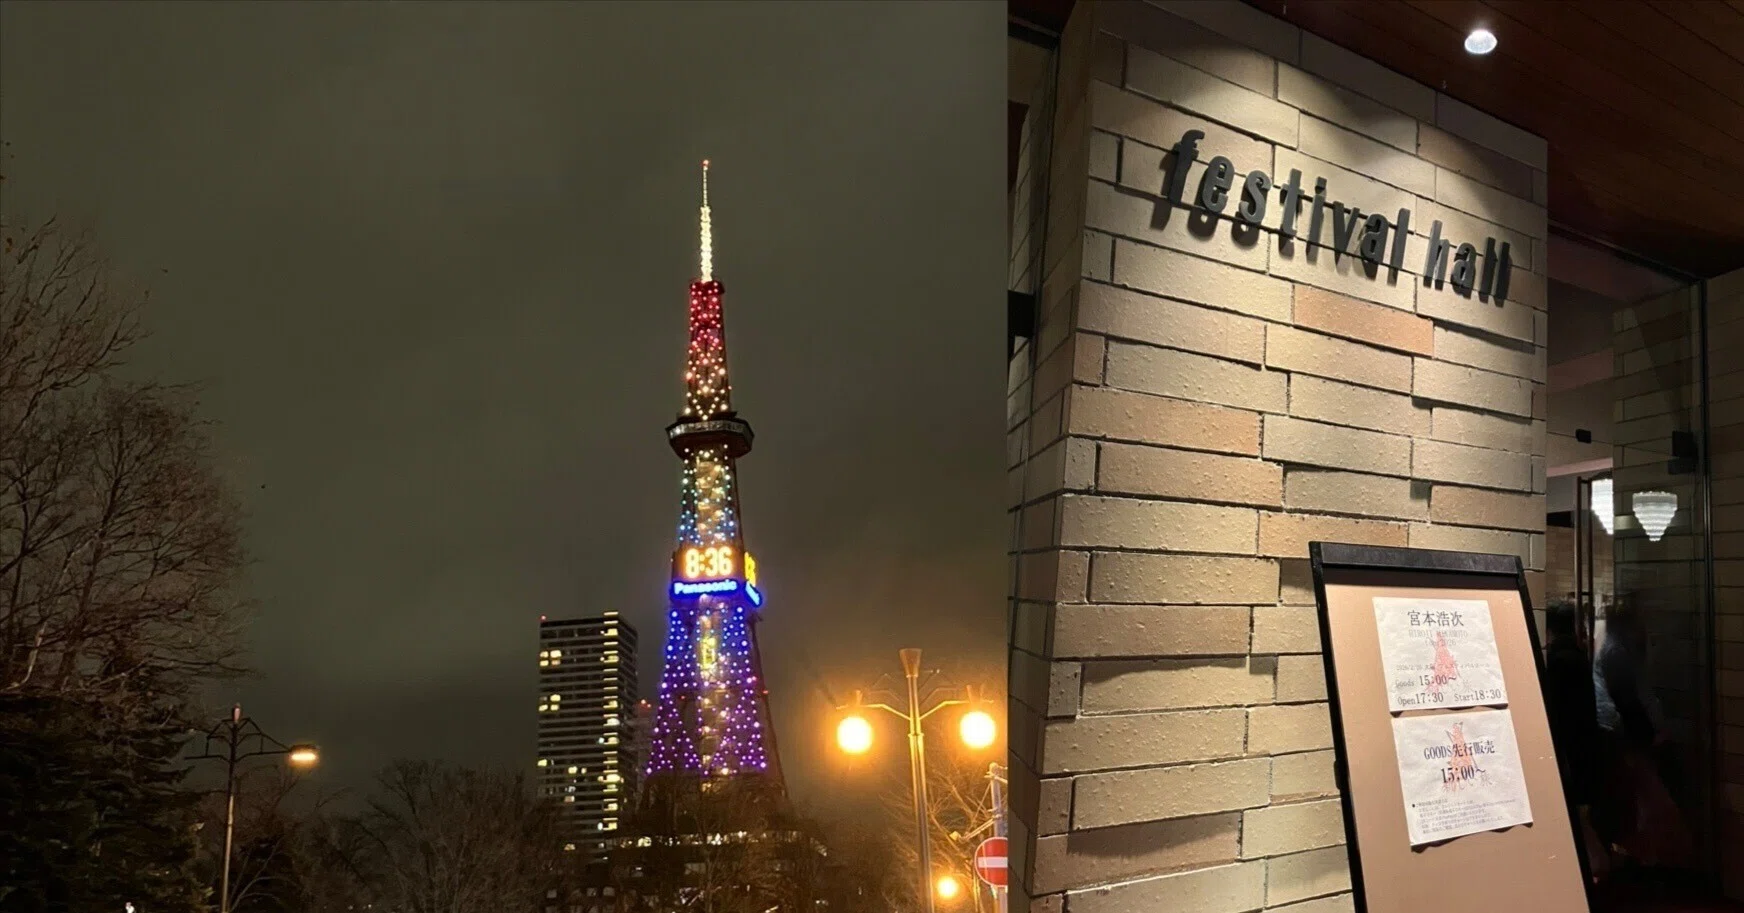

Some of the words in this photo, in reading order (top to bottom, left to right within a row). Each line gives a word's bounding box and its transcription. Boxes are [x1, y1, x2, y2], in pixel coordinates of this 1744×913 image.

[1166, 129, 1411, 270] festival
[1424, 219, 1511, 299] hall
[685, 546, 732, 579] 8:36
[674, 579, 737, 594] Panasonic
[1407, 610, 1464, 627] 宮本浩次
[1395, 679, 1415, 690] Goods
